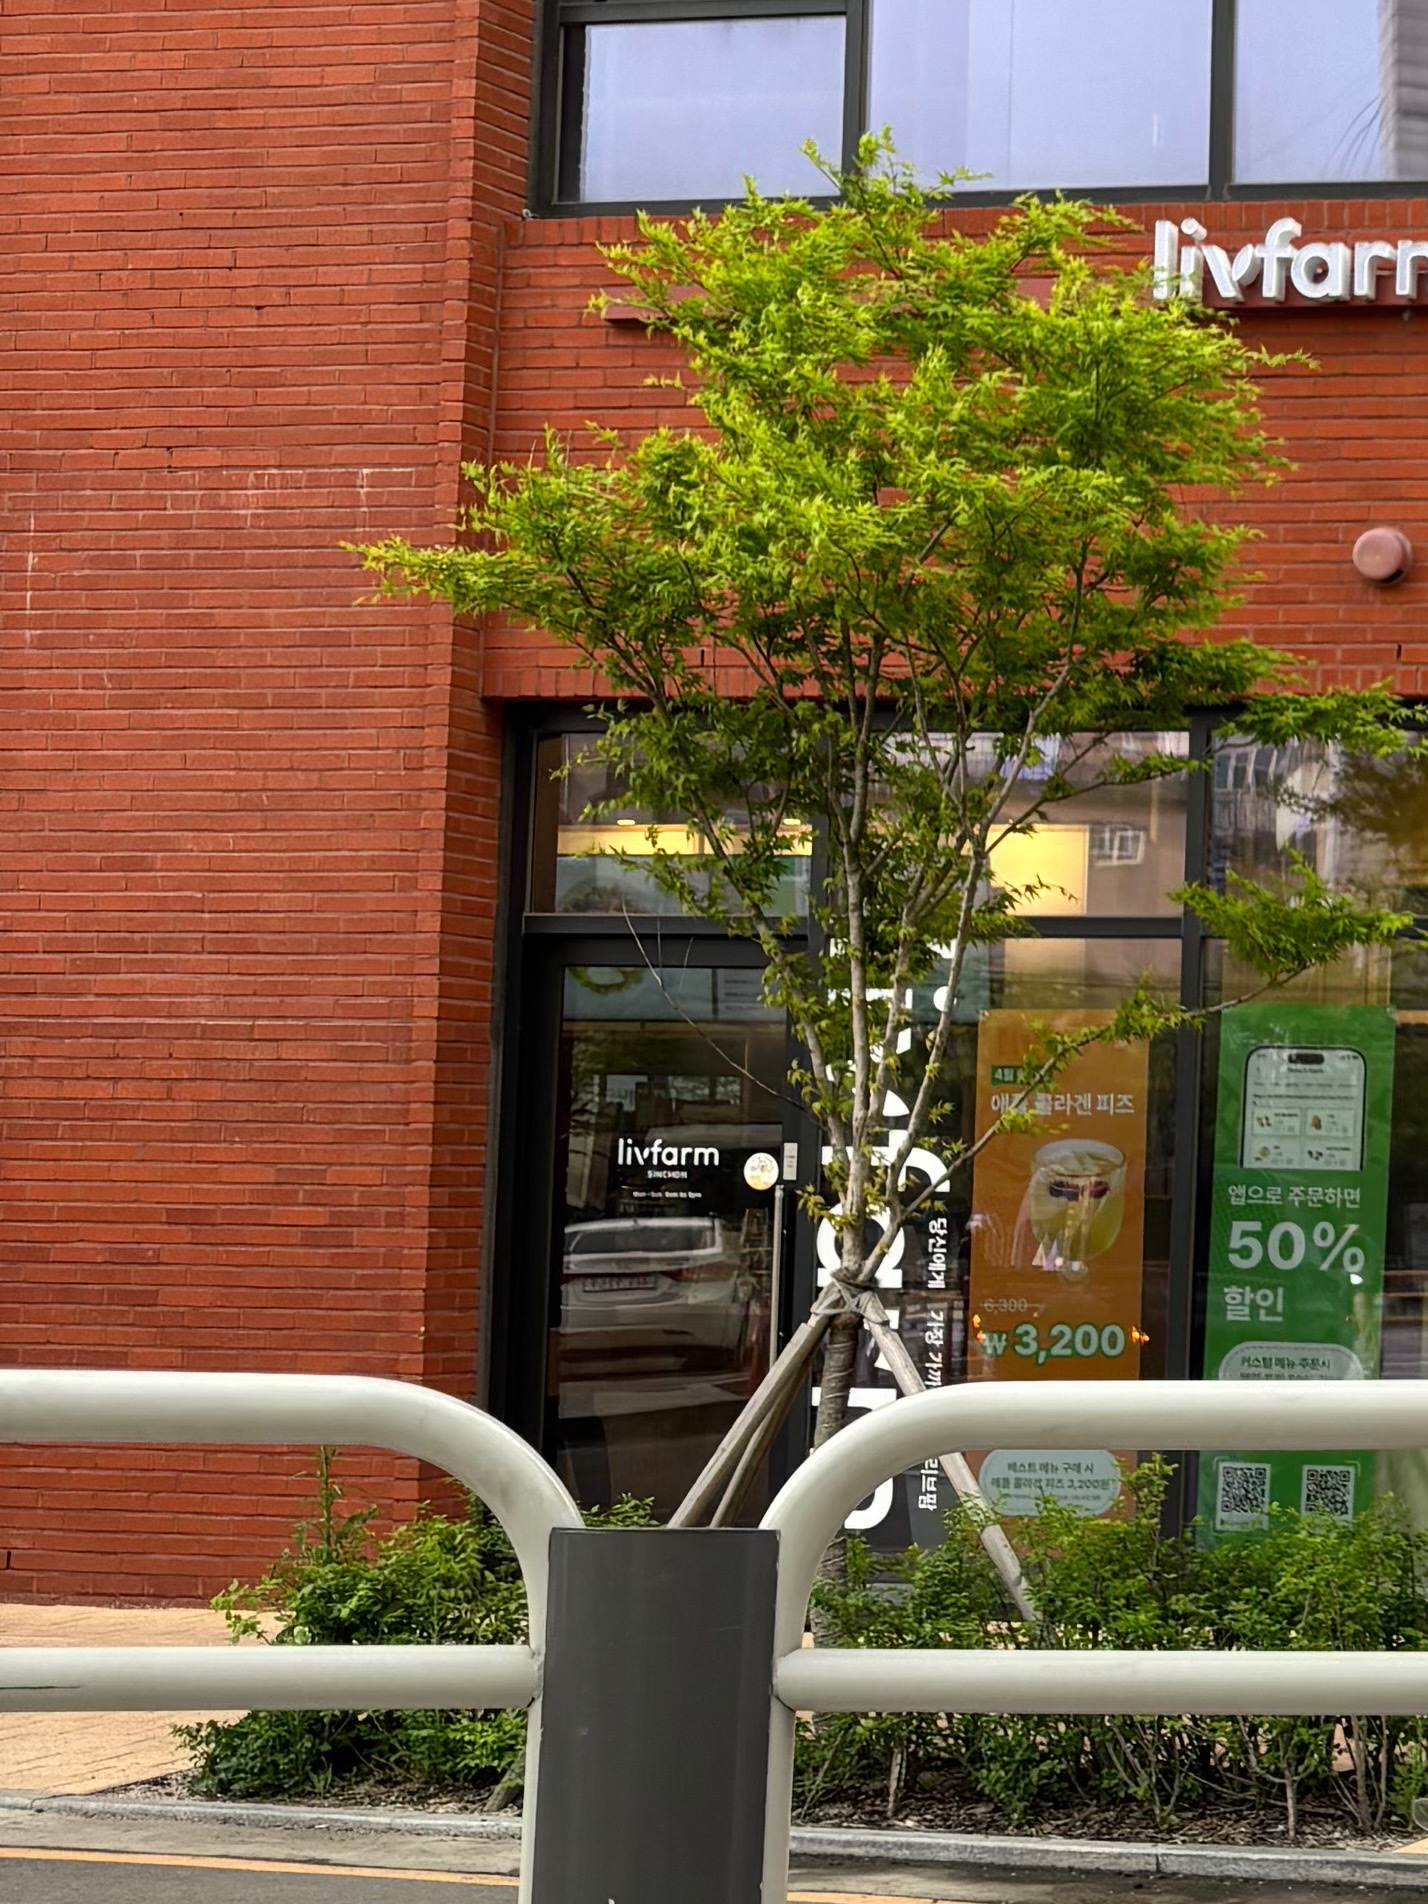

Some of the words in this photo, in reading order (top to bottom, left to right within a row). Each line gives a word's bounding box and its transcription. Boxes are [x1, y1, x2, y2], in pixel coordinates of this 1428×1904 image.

[1097, 1093, 1135, 1115] 피즈
[617, 1138, 720, 1166] livfarm
[1228, 1184, 1283, 1205] 앱으로
[1288, 1186, 1361, 1208] 주문하면
[928, 1217, 948, 1289] 당신에게
[1228, 1221, 1365, 1273] 50%
[1223, 1285, 1284, 1322] 할인
[925, 1310, 945, 1346] 가장
[1014, 1323, 1126, 1365] 3,200
[925, 1352, 942, 1388] 가까
